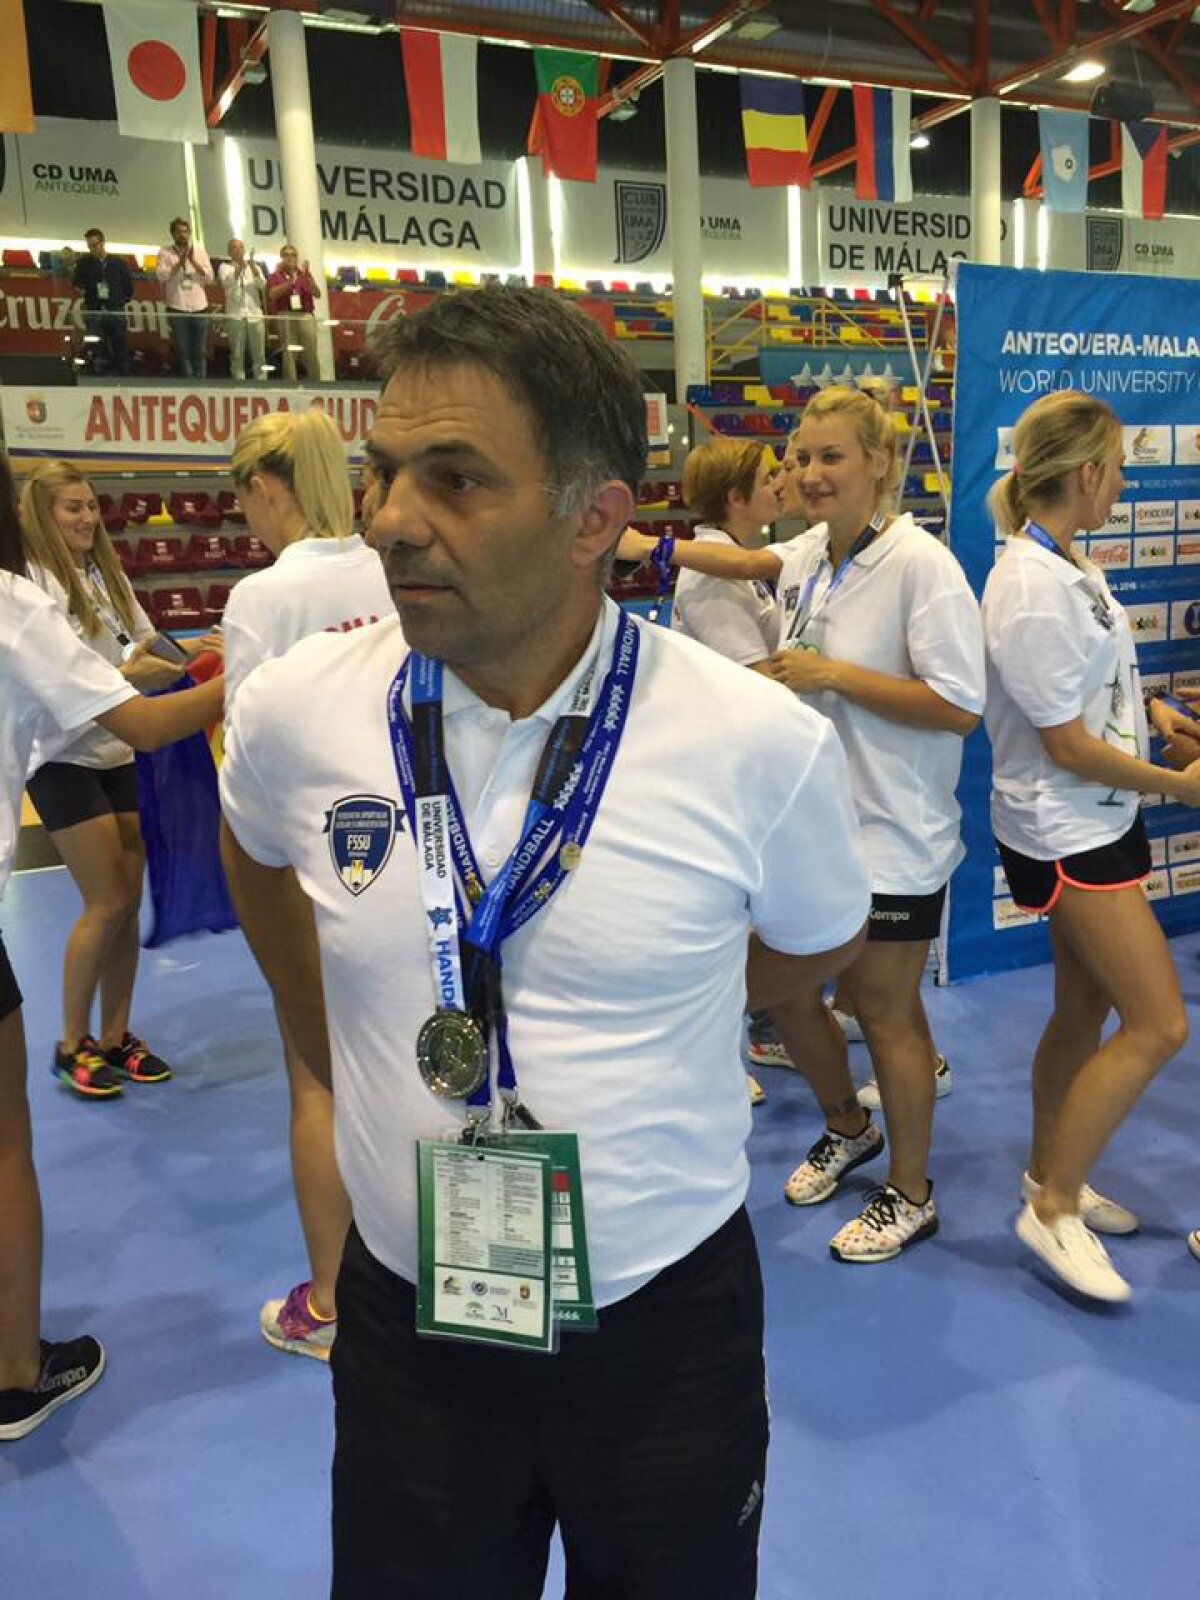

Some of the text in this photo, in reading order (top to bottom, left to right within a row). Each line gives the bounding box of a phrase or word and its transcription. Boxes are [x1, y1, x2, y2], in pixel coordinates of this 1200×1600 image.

[32, 163, 118, 184] CD UMA
[34, 179, 120, 196] ANTEQUERA
[319, 204, 480, 250] MÁLAGA
[708, 216, 741, 231] UMA
[829, 243, 866, 271] DE
[1000, 369, 1196, 394] WORLD UNIVERSITY
[421, 802, 431, 817] DE
[346, 834, 371, 851] FSSU
[432, 801, 448, 879] UNIVERSIDAD
